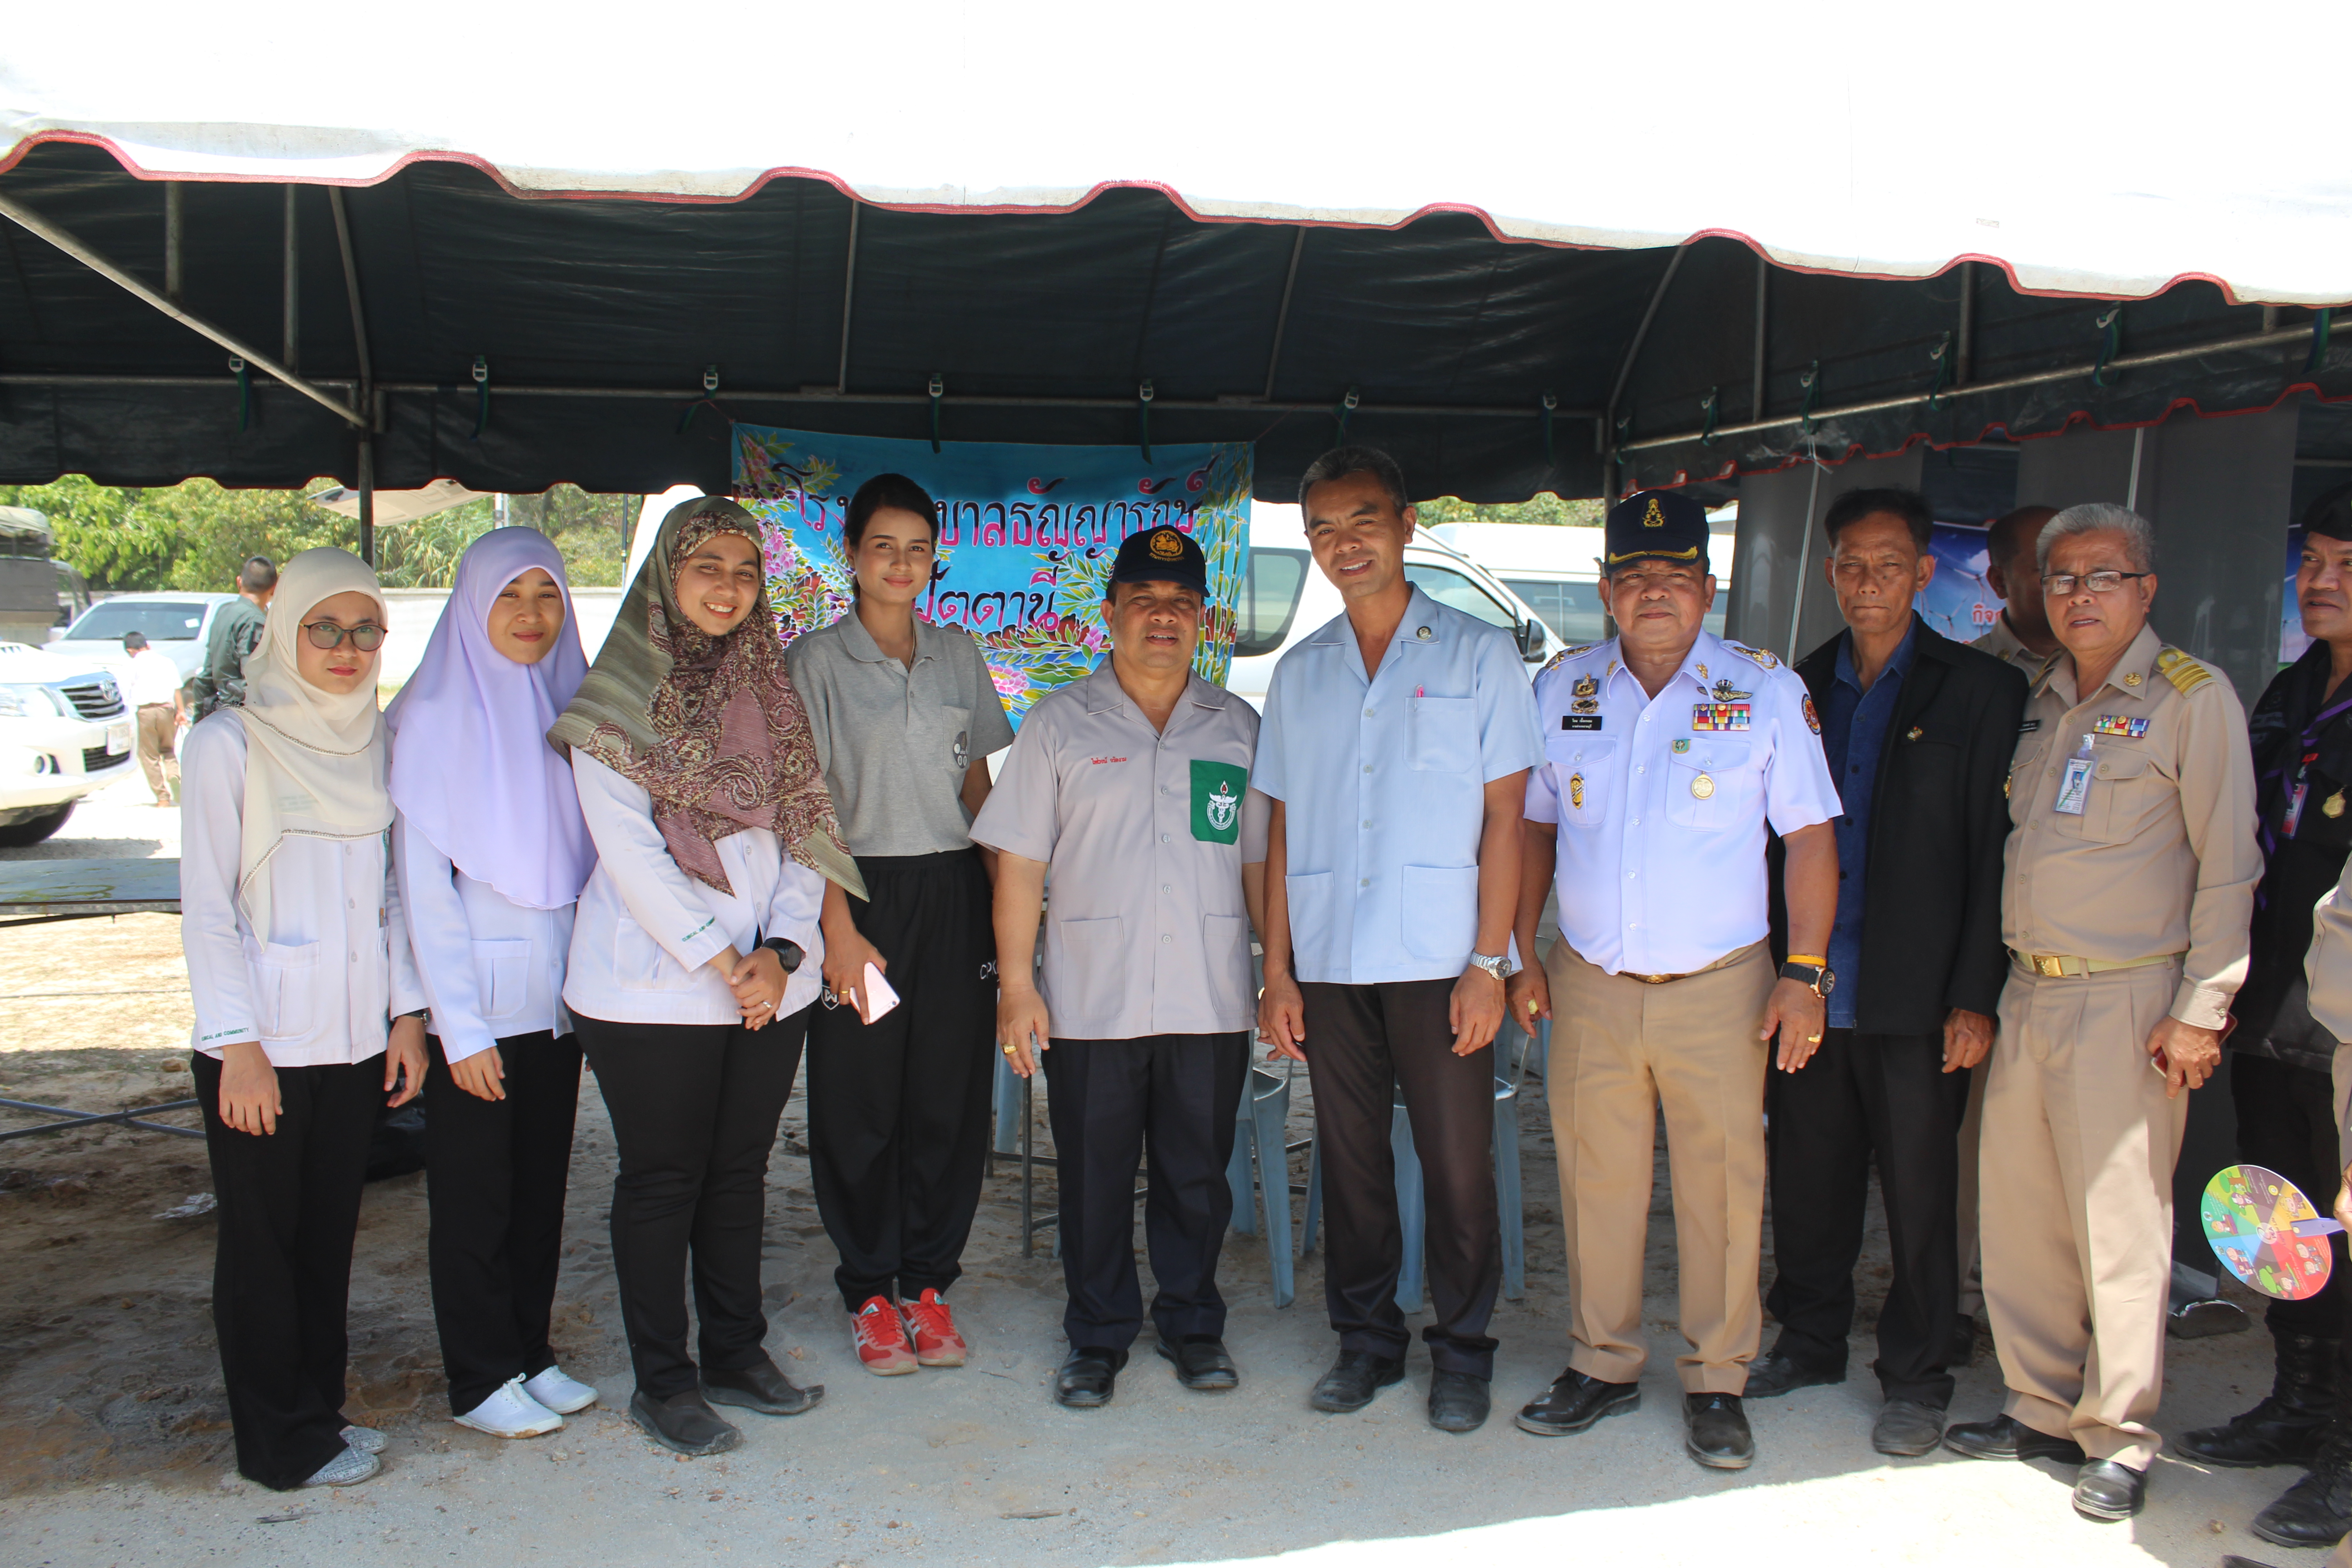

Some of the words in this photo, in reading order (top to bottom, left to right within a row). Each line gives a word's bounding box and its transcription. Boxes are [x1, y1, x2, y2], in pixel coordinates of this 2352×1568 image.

[771, 451, 1221, 564] โรงบาลธัญญารักษ์
[2269, 1227, 2277, 1239] PEA
